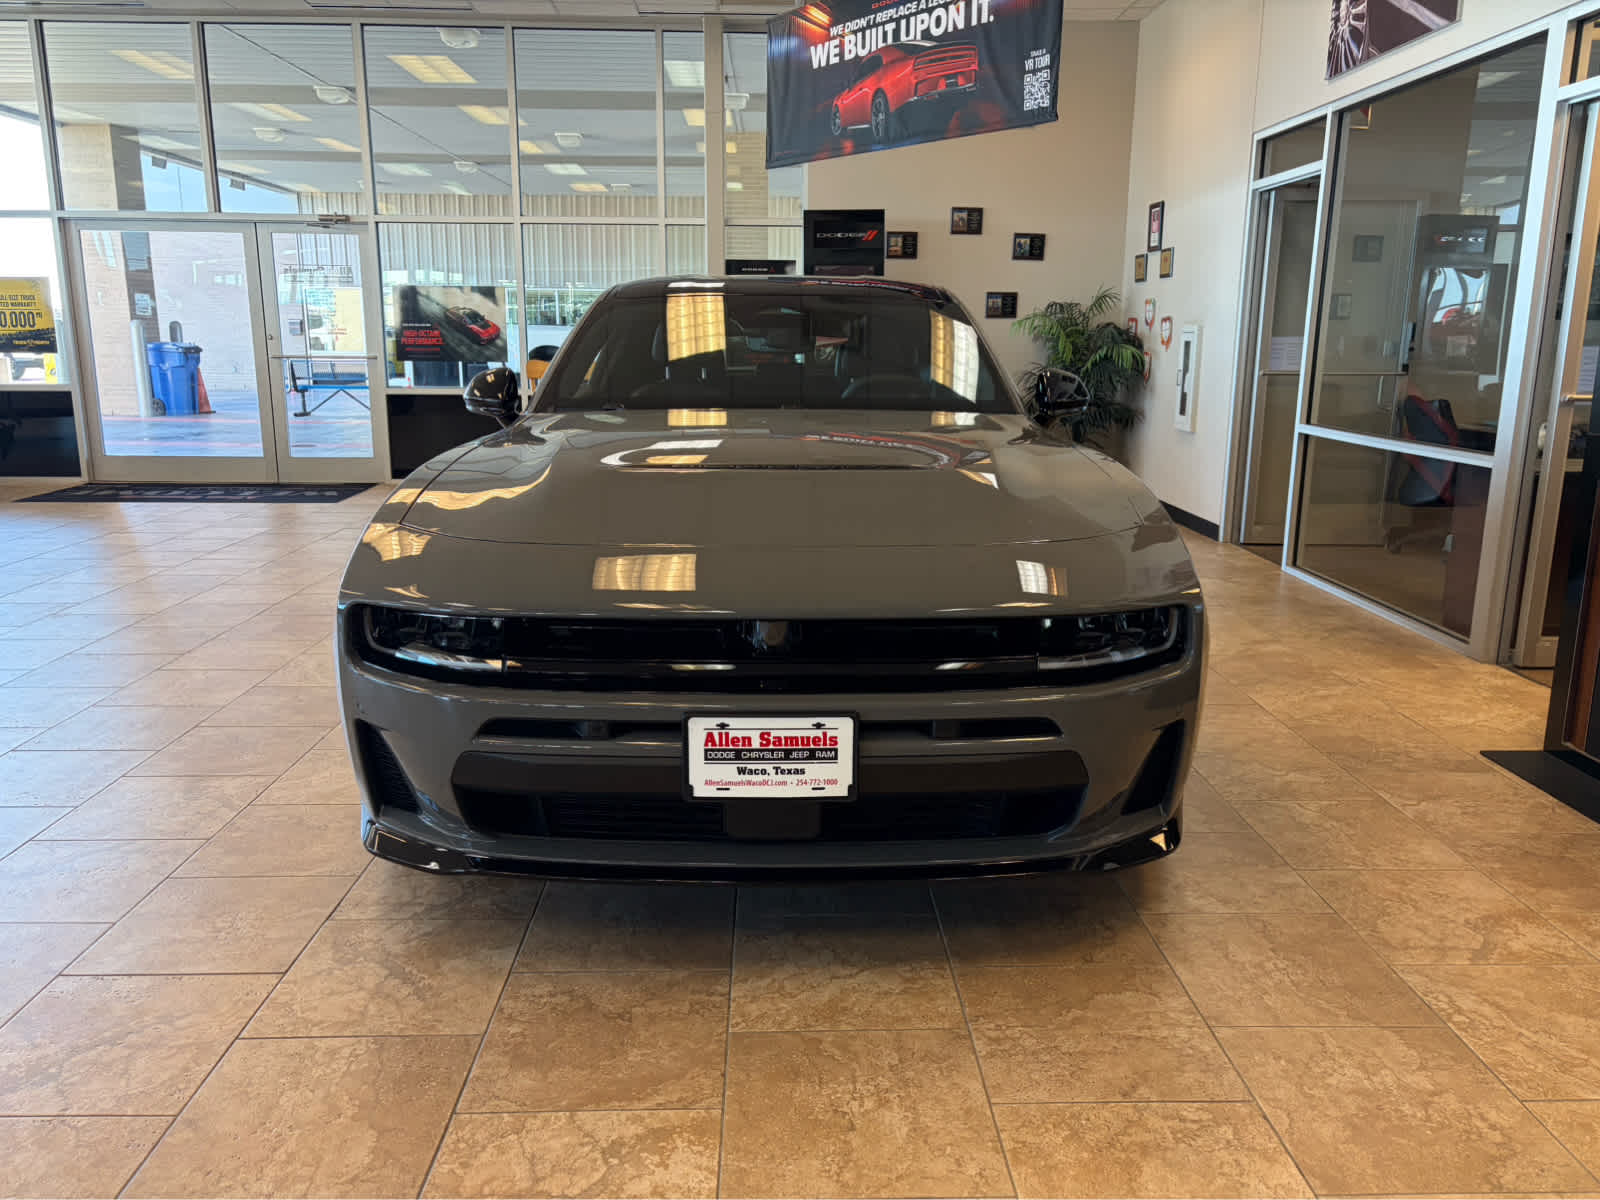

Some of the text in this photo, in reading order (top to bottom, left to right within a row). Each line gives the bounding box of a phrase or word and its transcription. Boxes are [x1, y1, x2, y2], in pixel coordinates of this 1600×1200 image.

[830, 24, 844, 37] WE
[845, 14, 875, 33] DIDN'T
[875, 2, 917, 23] REPLACE
[916, 0, 926, 11] A
[810, 0, 995, 69] WE BUILT UPON IT.
[1024, 54, 1050, 71] VR TOUR
[704, 731, 838, 748] Allen Samuels
[707, 751, 736, 759] DODGE
[741, 751, 784, 759] CHRYSLER
[789, 751, 809, 759] JEEP
[736, 766, 806, 776] Waco, Texas
[796, 778, 838, 786] 254-772-1000
